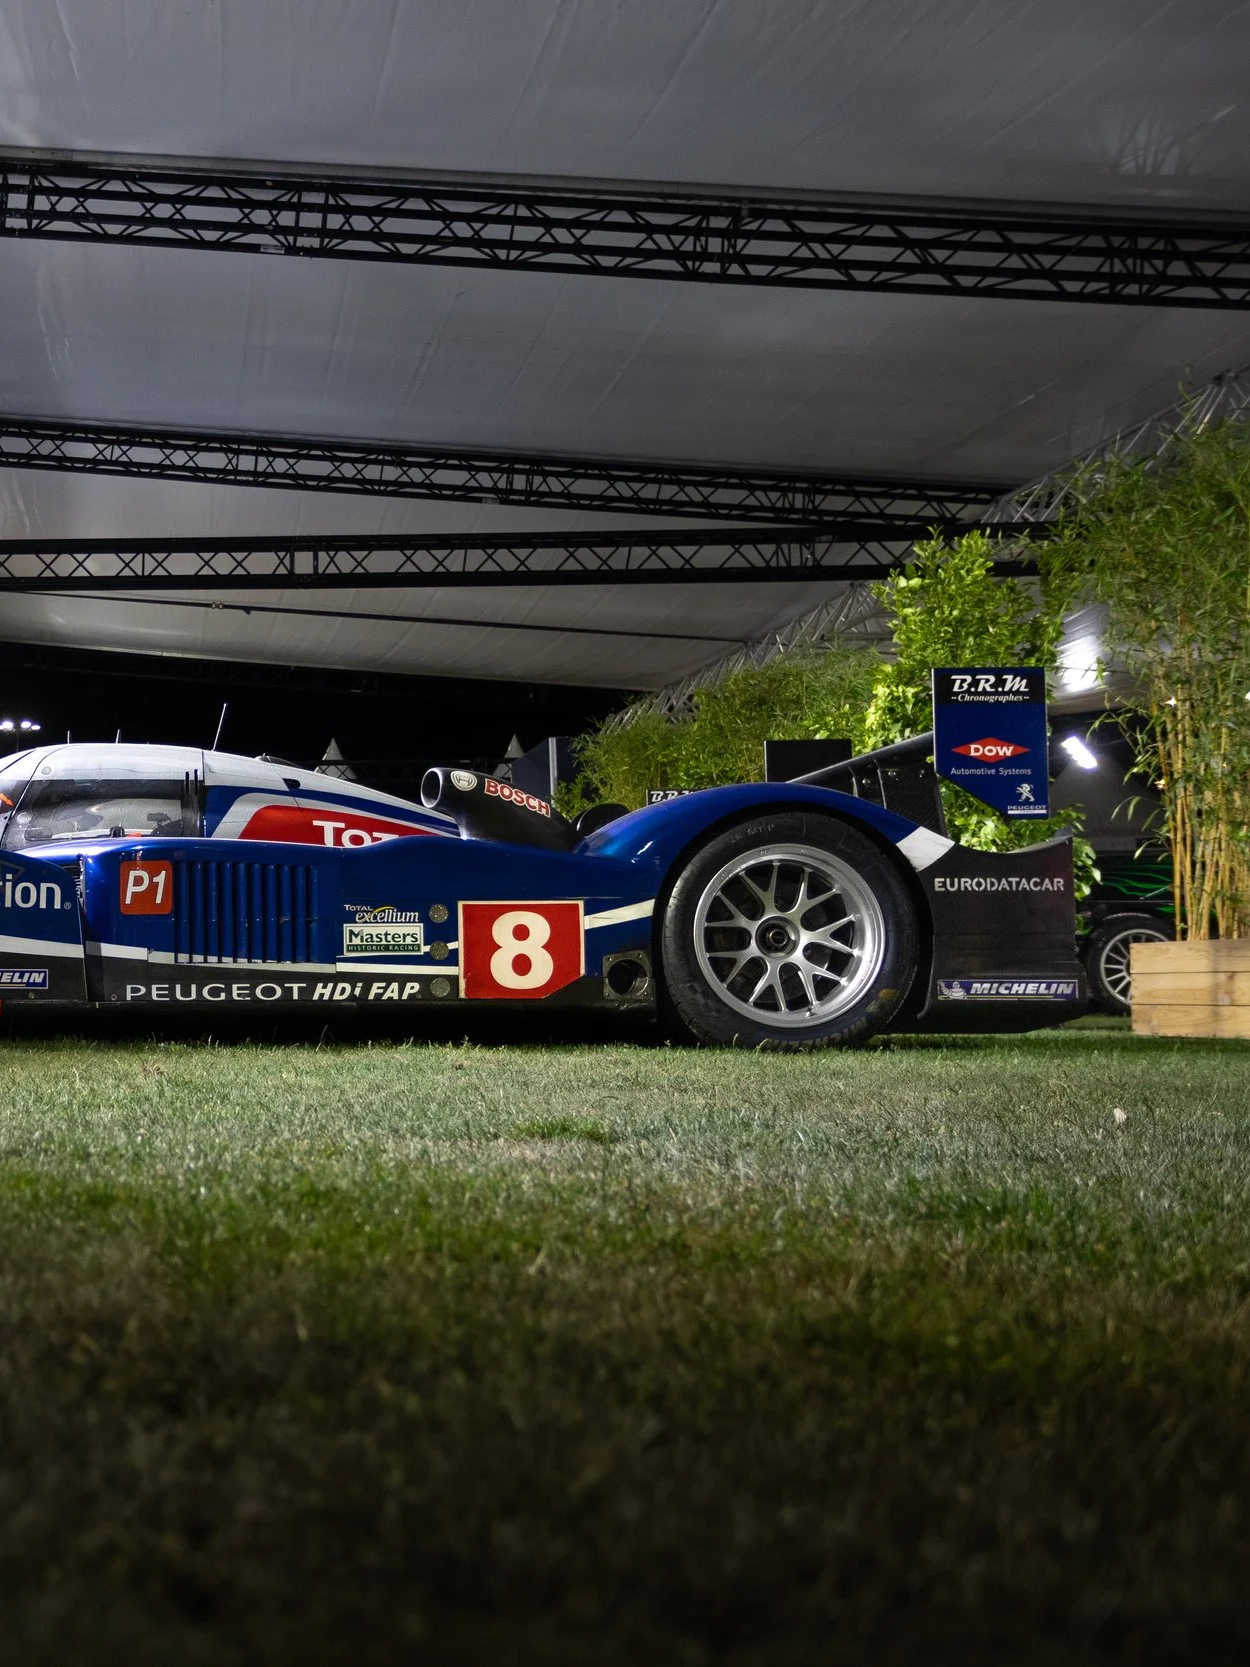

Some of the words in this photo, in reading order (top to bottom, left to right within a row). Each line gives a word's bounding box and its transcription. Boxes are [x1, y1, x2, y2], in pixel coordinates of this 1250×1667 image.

[950, 674, 1030, 692] B.R.M
[957, 693, 1024, 703] Chronographes
[969, 744, 1015, 757] DOW
[950, 767, 996, 775] Automotive
[999, 767, 1032, 776] Systems
[484, 778, 551, 817] BOSCH
[125, 870, 167, 905] P1
[934, 877, 1065, 892] EURODATACAR
[355, 908, 419, 923] excellium
[348, 928, 419, 944] Masters
[490, 911, 554, 990] 8
[125, 983, 307, 1001] PEUGEOT
[312, 982, 363, 1001] HDi
[367, 982, 420, 1000] FAP
[969, 983, 1074, 994] MICHELIN
